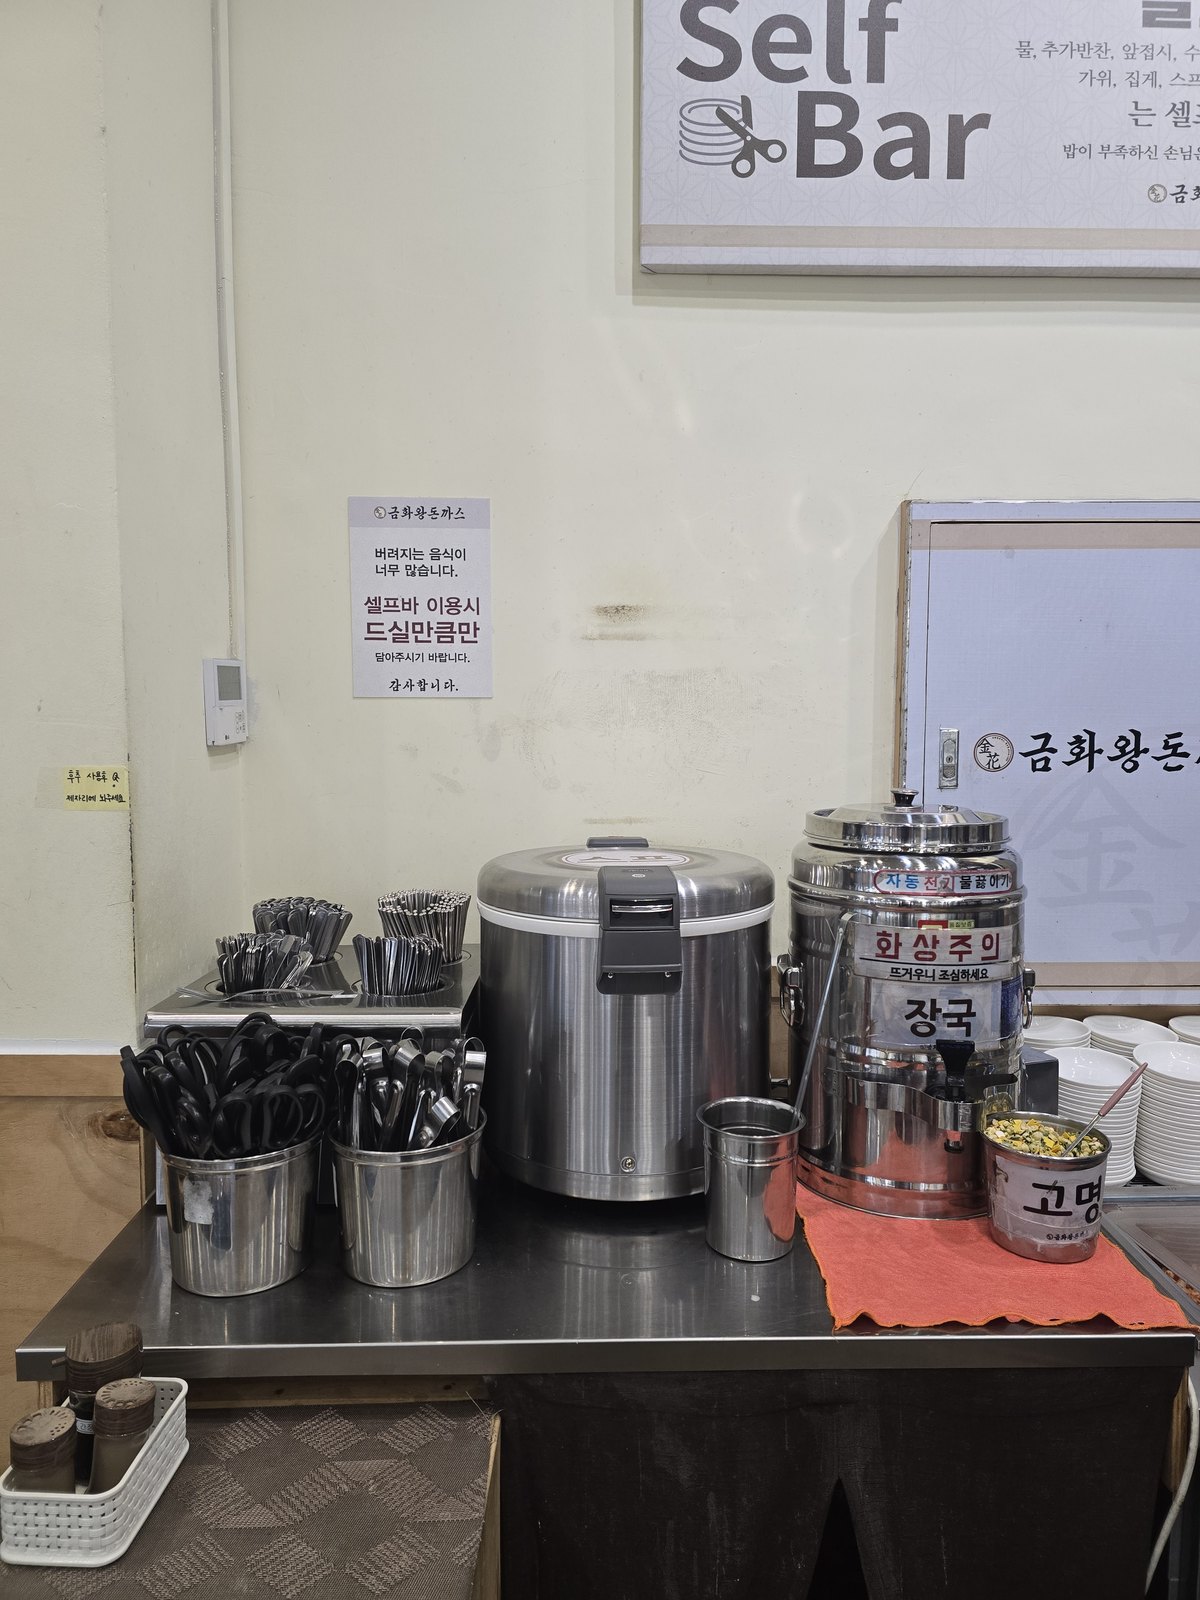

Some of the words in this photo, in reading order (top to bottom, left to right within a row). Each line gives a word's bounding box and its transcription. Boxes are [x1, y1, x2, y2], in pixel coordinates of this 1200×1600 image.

[676, 0, 900, 84] Self
[1016, 41, 1036, 59] 물,
[1042, 41, 1113, 60] 추가반찬,
[1123, 43, 1176, 61] 앞접시,
[1079, 70, 1116, 88] 가위,
[1125, 71, 1161, 88] 집게,
[1128, 101, 1156, 126] 는
[796, 91, 991, 180] Bar
[1063, 144, 1091, 159] 밥이
[1098, 145, 1158, 160] 부족하신
[388, 506, 465, 520] 금화왕돈까스
[375, 548, 424, 560] 버려지는
[429, 548, 465, 561] 음식이
[376, 564, 400, 576] 너무
[405, 564, 457, 577] 많습니다.
[364, 596, 419, 614] 셀프바
[427, 597, 479, 615] 이용시
[364, 621, 480, 643] 드실만큼만
[376, 652, 424, 662] 담아주시기
[429, 653, 470, 662] 바랍니다.
[389, 679, 458, 692] 감사합니다.
[1019, 729, 1200, 773] 금화왕돈
[874, 931, 1001, 963] 화상주의
[889, 967, 935, 982] 뜨거우니
[938, 969, 990, 982] 조심하세요
[905, 999, 976, 1038] 장국
[1023, 1175, 1102, 1224] 고명
